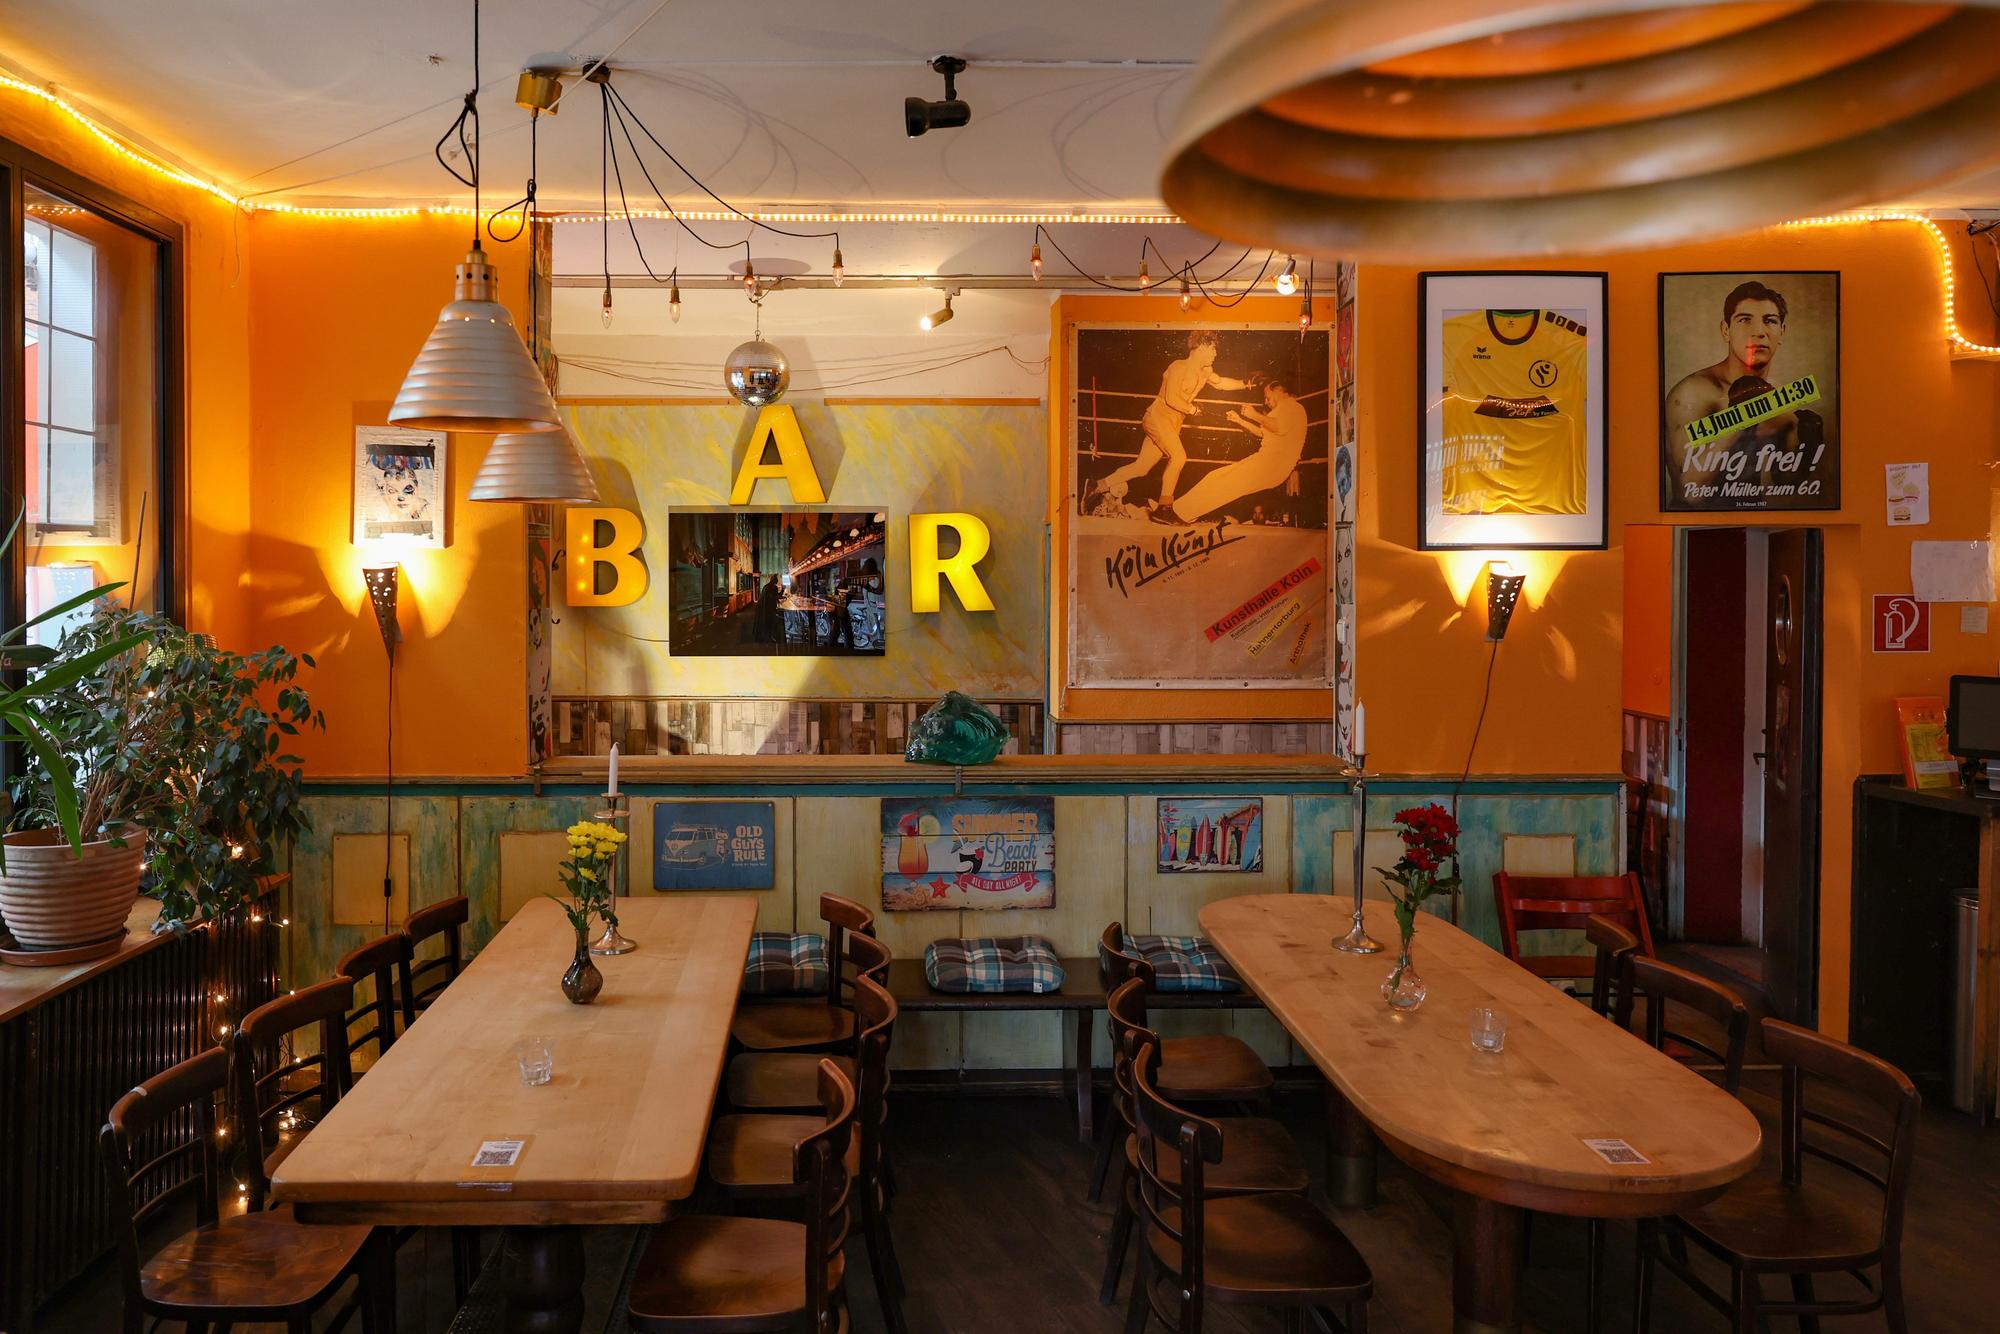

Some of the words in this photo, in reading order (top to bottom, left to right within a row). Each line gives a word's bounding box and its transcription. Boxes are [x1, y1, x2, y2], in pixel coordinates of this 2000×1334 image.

[1744, 396, 1772, 418] um
[1773, 377, 1815, 408] 11:30
[1755, 442, 1806, 473] frei
[1683, 482, 1719, 498] Peter
[1720, 481, 1764, 497] Müller
[1765, 484, 1794, 496] zum
[1798, 480, 1820, 495] 60.
[1105, 544, 1158, 599] Köln
[1212, 587, 1280, 636] Kunsthalle
[1279, 565, 1313, 589] Köln
[736, 825, 763, 838] OLD
[952, 813, 1040, 842] SUMMER
[731, 838, 764, 850] GUYS
[732, 849, 766, 862] RULE
[984, 832, 1037, 868] Beach
[1004, 861, 1037, 873] PARTY
[972, 876, 981, 887] ALL
[995, 881, 1005, 890] ALL
